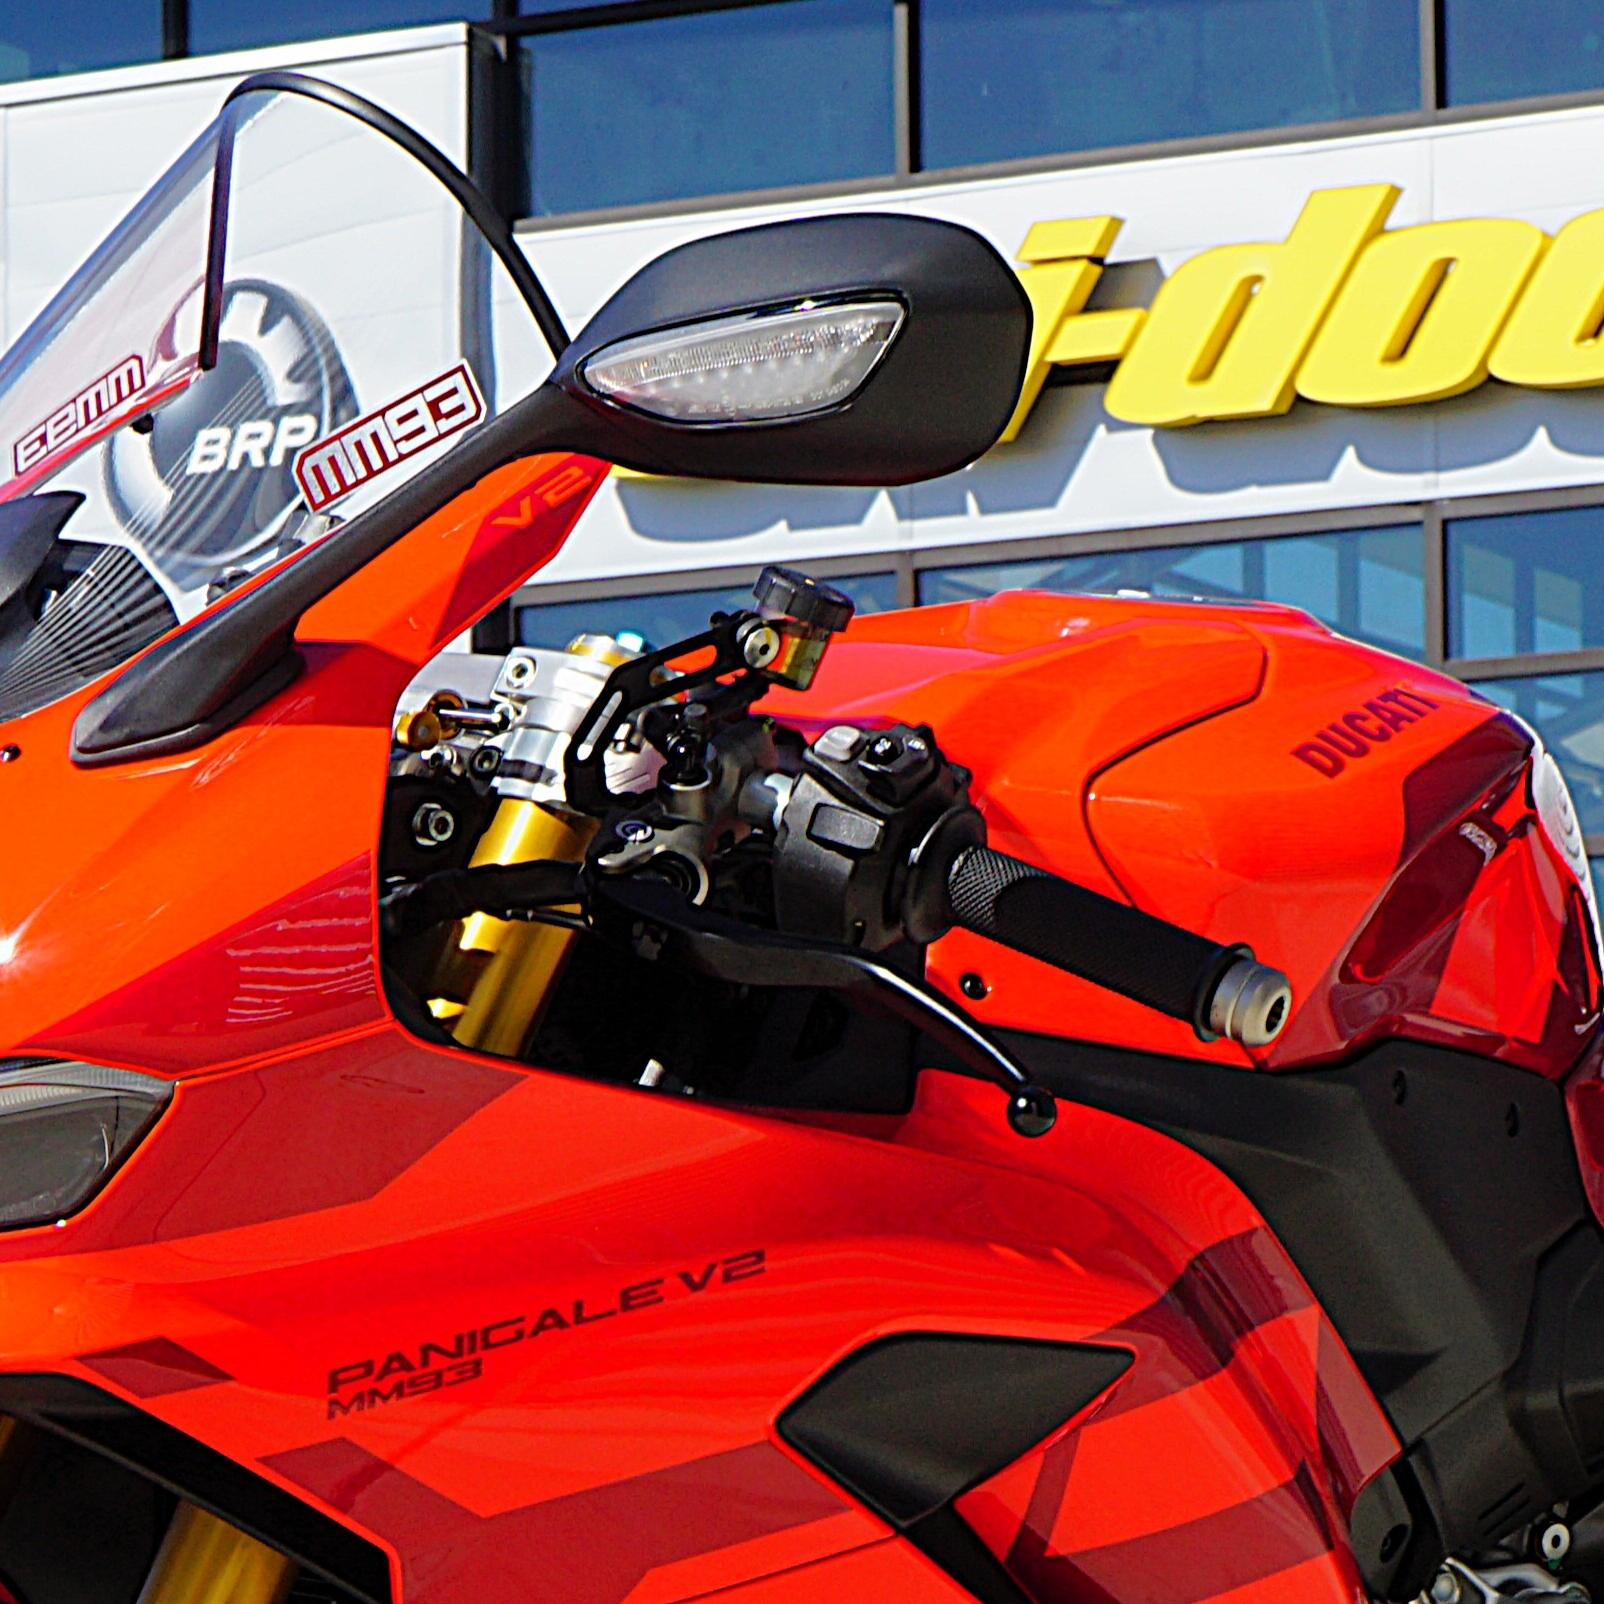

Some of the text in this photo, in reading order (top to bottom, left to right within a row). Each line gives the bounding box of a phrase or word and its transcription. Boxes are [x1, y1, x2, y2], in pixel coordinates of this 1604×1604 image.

[185, 413, 318, 475] BRP
[300, 368, 479, 507] MM93
[490, 465, 593, 528] V2
[1291, 687, 1440, 779] DUCATI
[327, 1249, 766, 1394] PANIGALE V2
[326, 1357, 483, 1421] MM93
